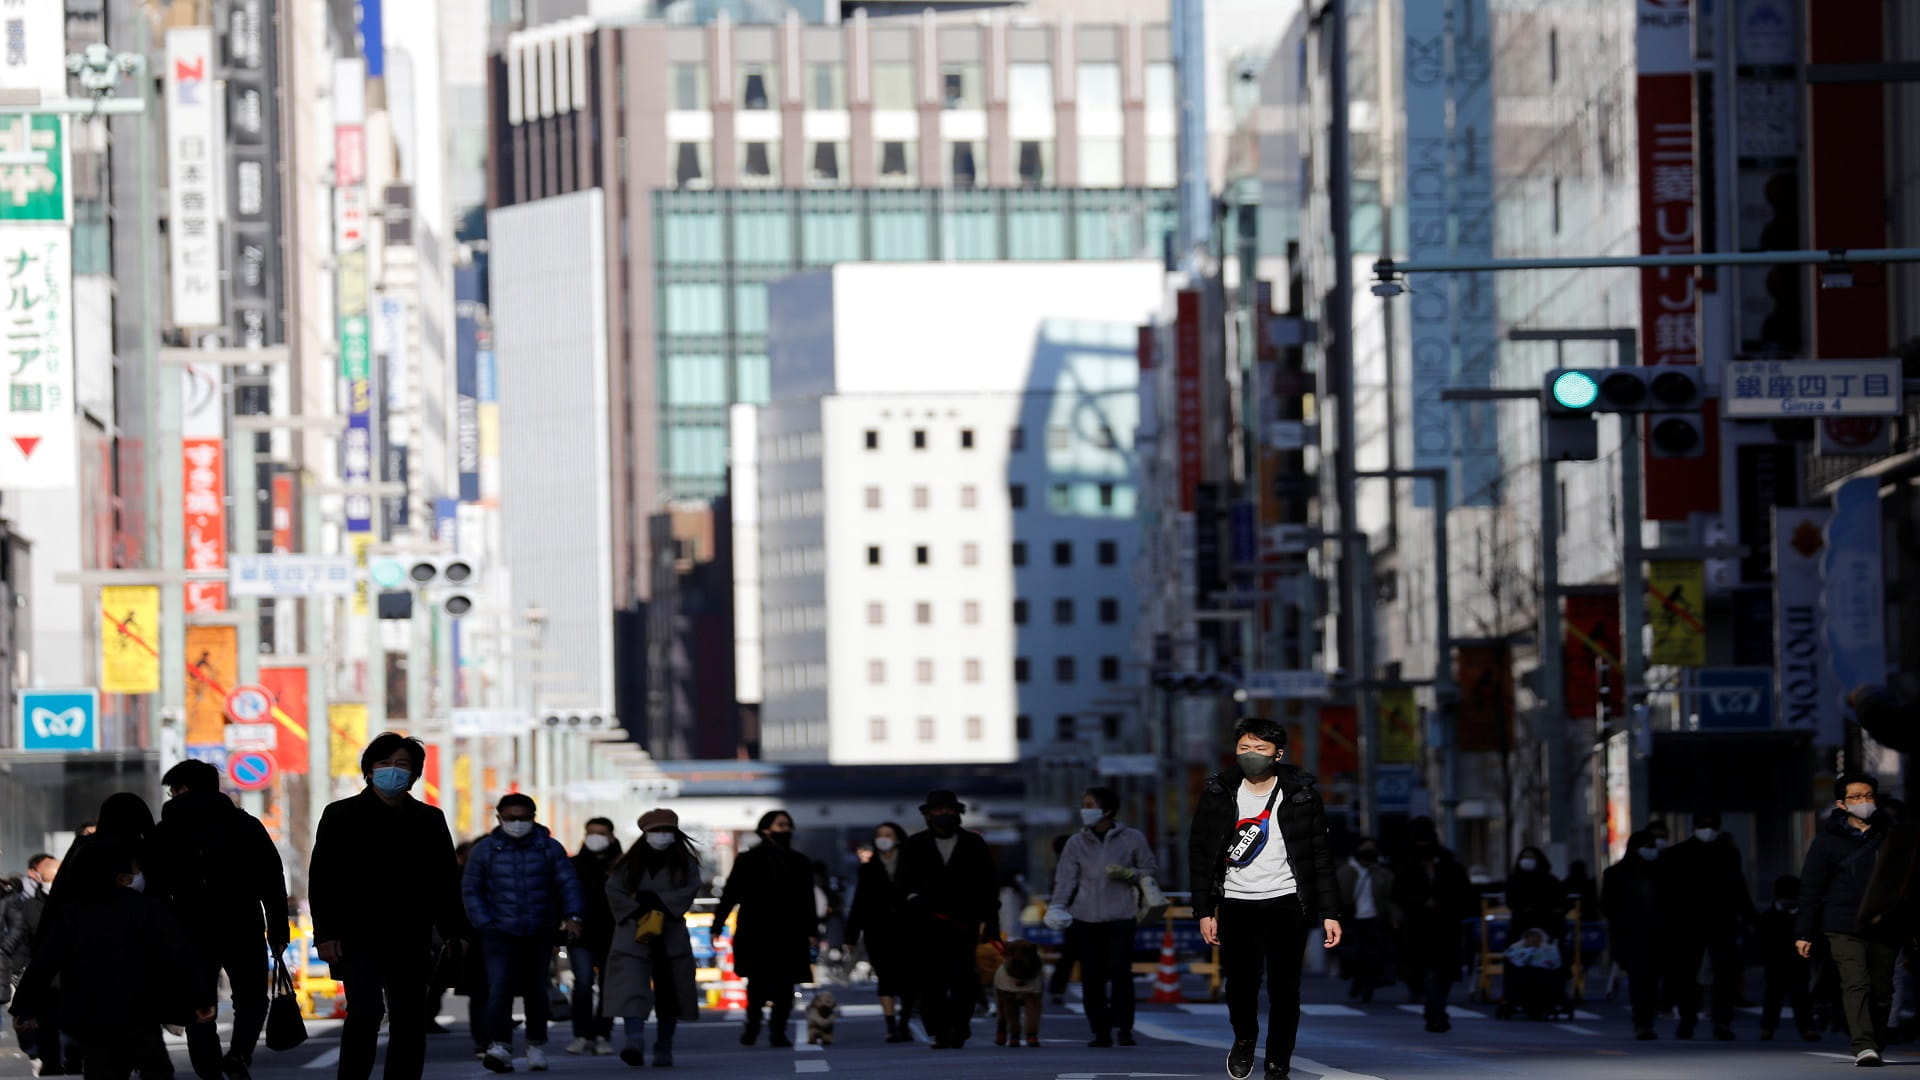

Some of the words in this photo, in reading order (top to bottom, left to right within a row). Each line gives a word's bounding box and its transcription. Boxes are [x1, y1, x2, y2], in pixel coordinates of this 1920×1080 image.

[6, 249, 42, 412] ナルニア国
[1735, 374, 1889, 399] 銀座四丁目
[1780, 399, 1825, 412] Ginza
[1831, 399, 1842, 411] 4
[1233, 829, 1257, 857] PARIS
